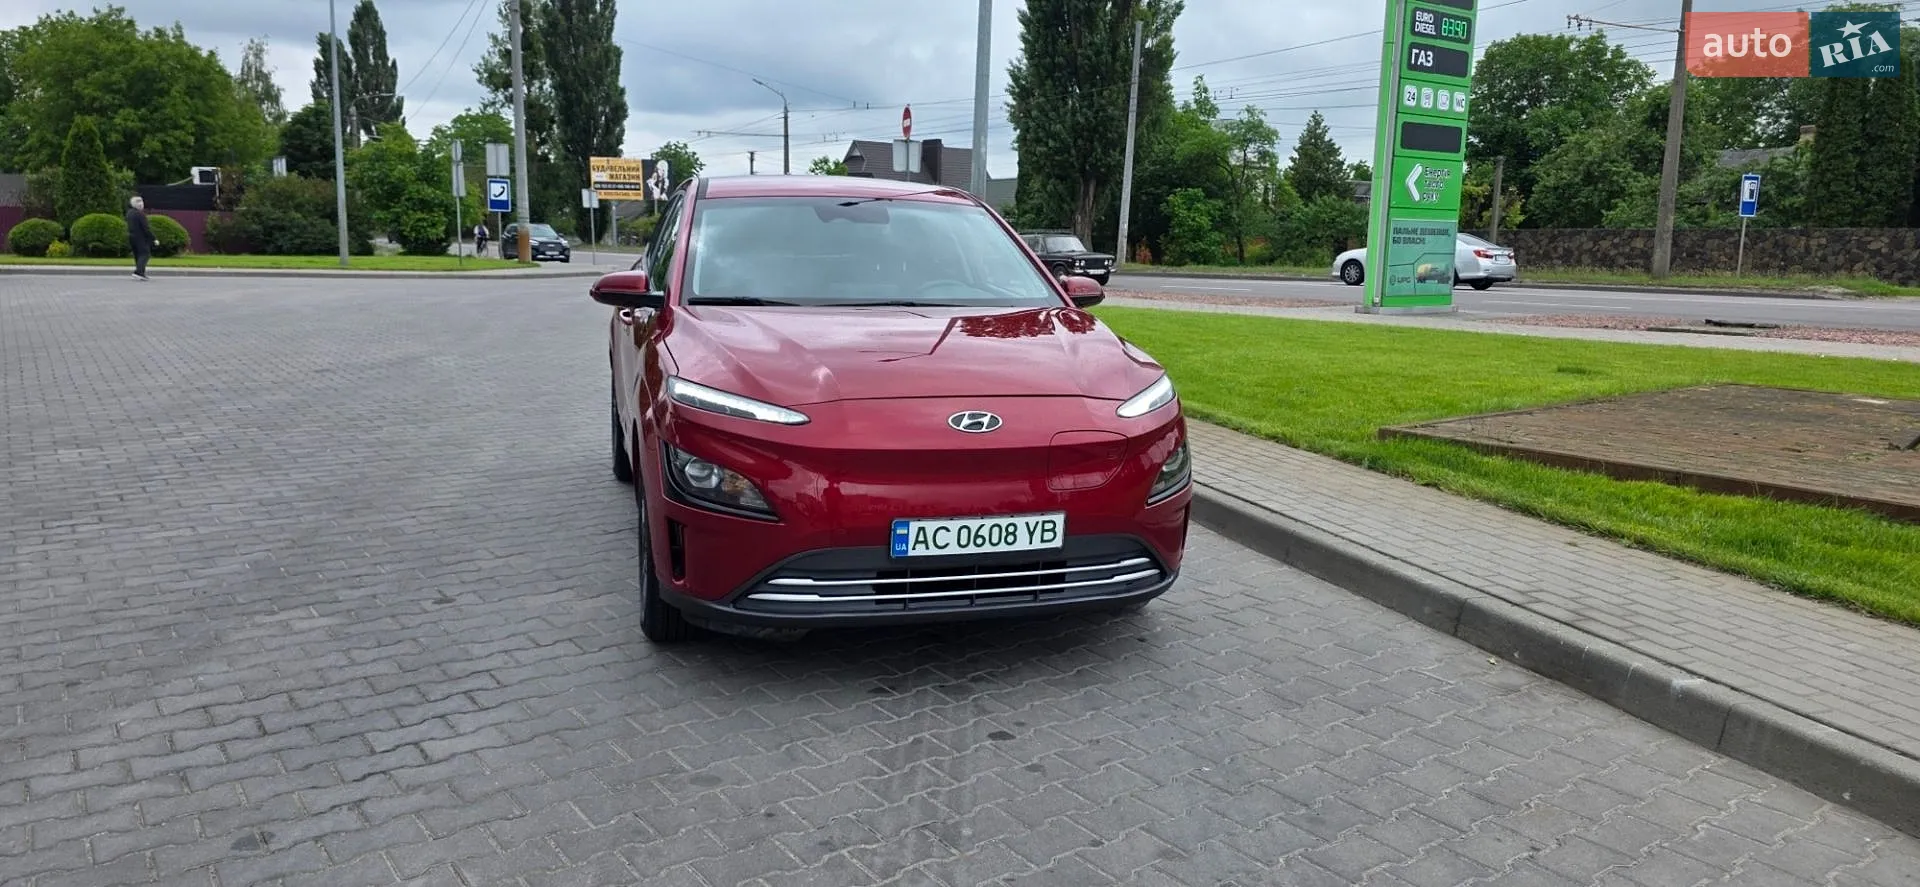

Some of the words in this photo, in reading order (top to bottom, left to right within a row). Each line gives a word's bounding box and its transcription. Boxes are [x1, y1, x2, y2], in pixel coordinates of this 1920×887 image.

[1415, 11, 1434, 23] EURO
[1414, 22, 1436, 35] DIESEL
[1411, 48, 1433, 67] ГАЗ
[1407, 91, 1416, 102] 24
[911, 526, 952, 551] AC
[956, 522, 1019, 549] 0608
[1025, 519, 1058, 545] YB
